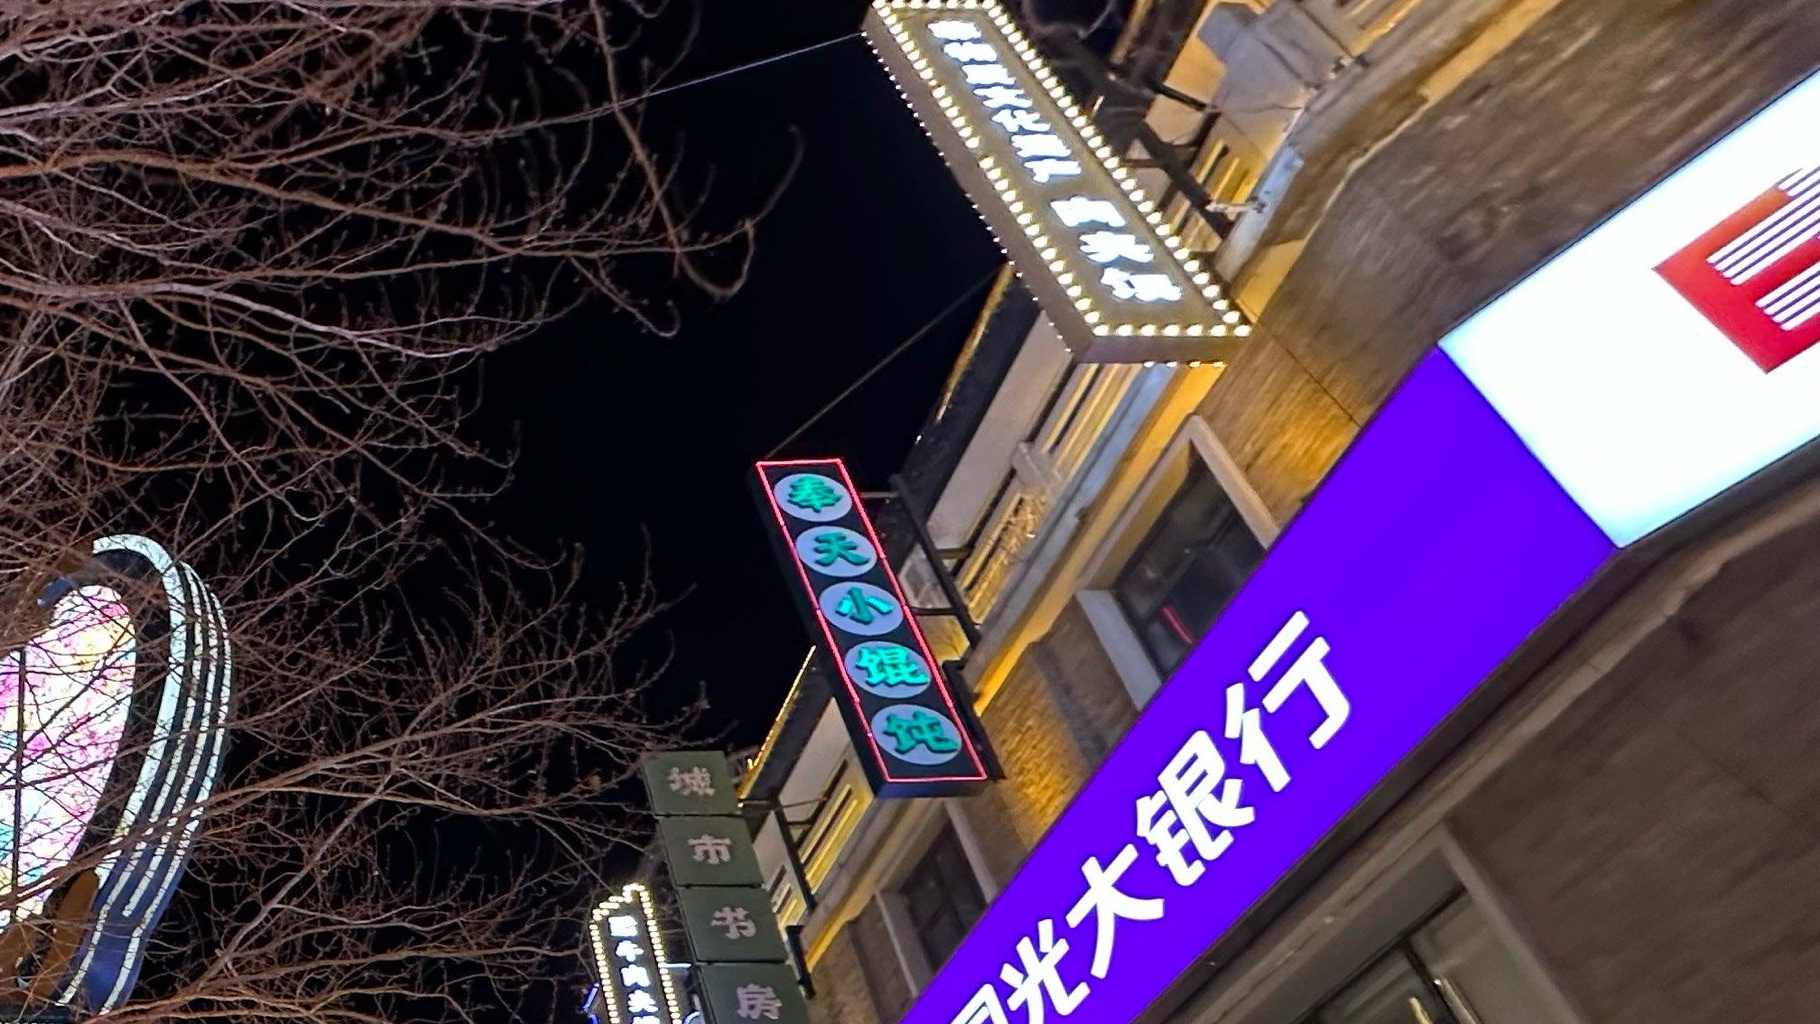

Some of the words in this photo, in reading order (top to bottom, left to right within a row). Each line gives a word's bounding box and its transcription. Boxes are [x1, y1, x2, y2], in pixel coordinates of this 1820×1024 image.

[787, 476, 959, 754] 奉天小馄饨
